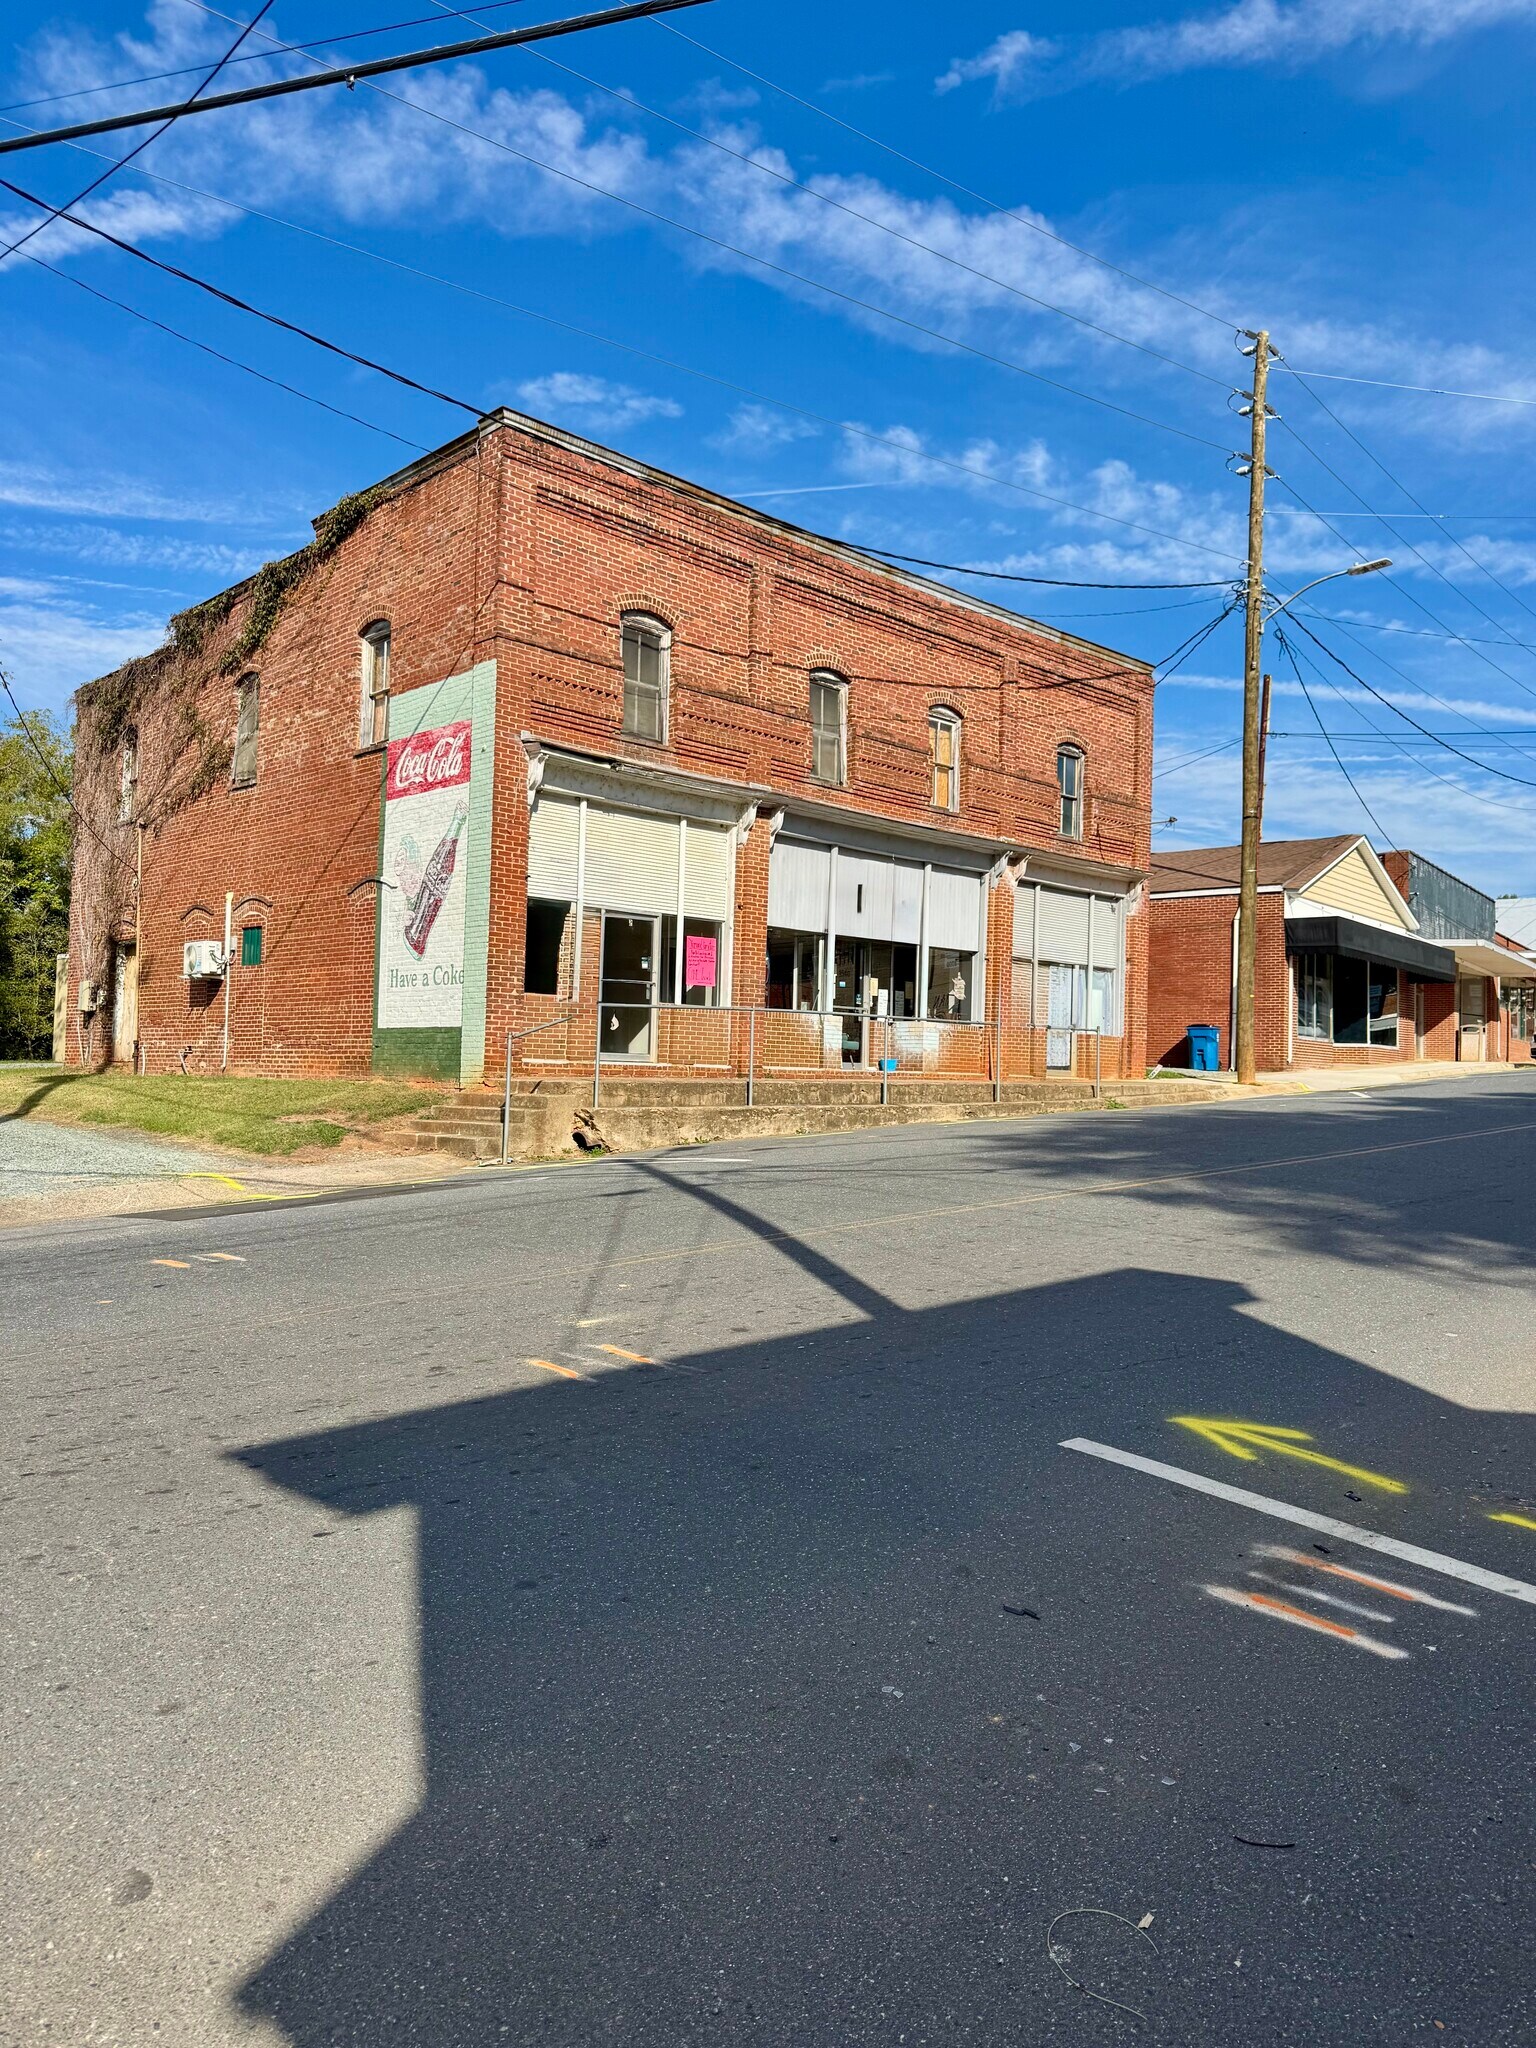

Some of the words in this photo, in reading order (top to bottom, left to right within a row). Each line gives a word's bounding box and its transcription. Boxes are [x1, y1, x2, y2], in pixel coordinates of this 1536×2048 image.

[390, 968, 418, 988] Have
[422, 973, 430, 987] a
[433, 964, 464, 986] Coke
